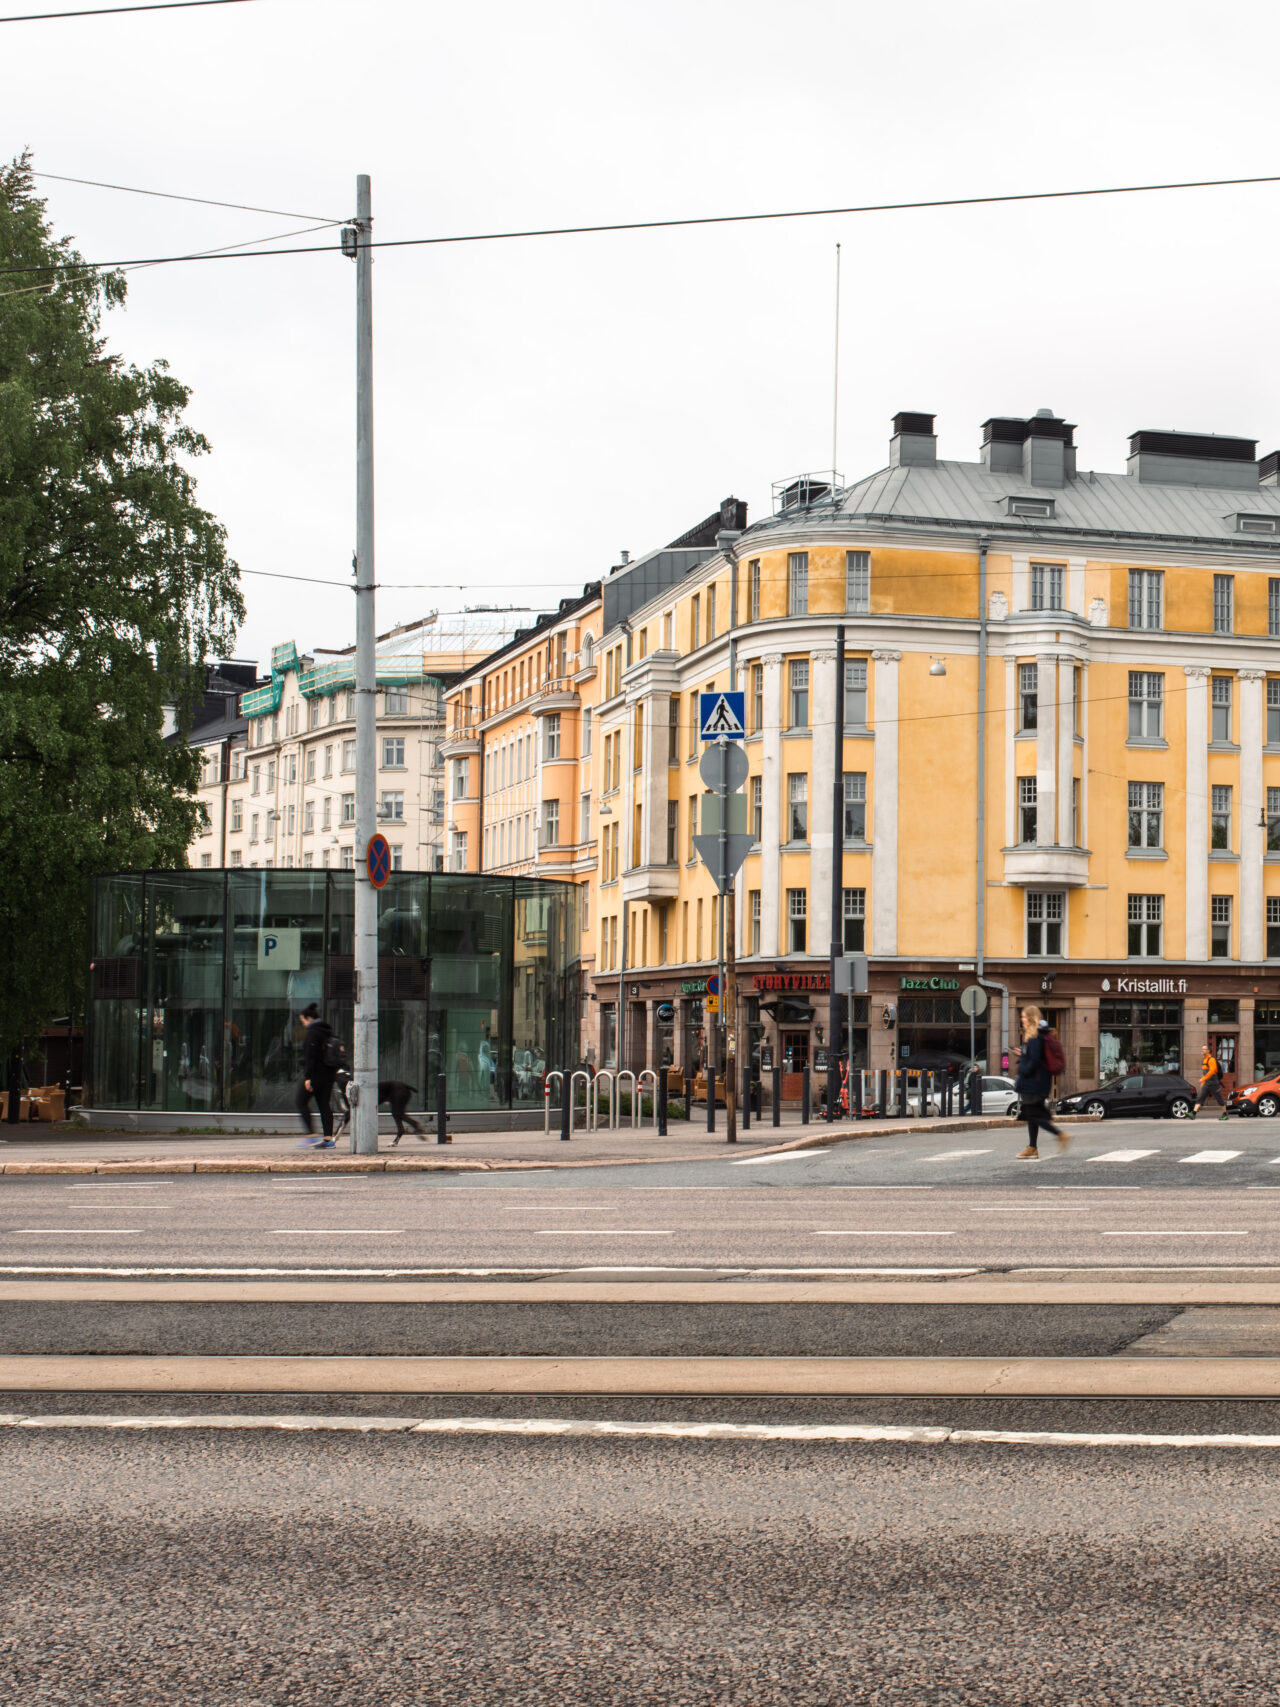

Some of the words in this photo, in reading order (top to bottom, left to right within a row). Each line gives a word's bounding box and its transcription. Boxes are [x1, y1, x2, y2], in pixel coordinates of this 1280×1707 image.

[264, 938, 277, 956] P
[901, 977, 928, 990] Jazz
[930, 977, 960, 990] Club
[1117, 978, 1187, 993] Kristallit.fi
